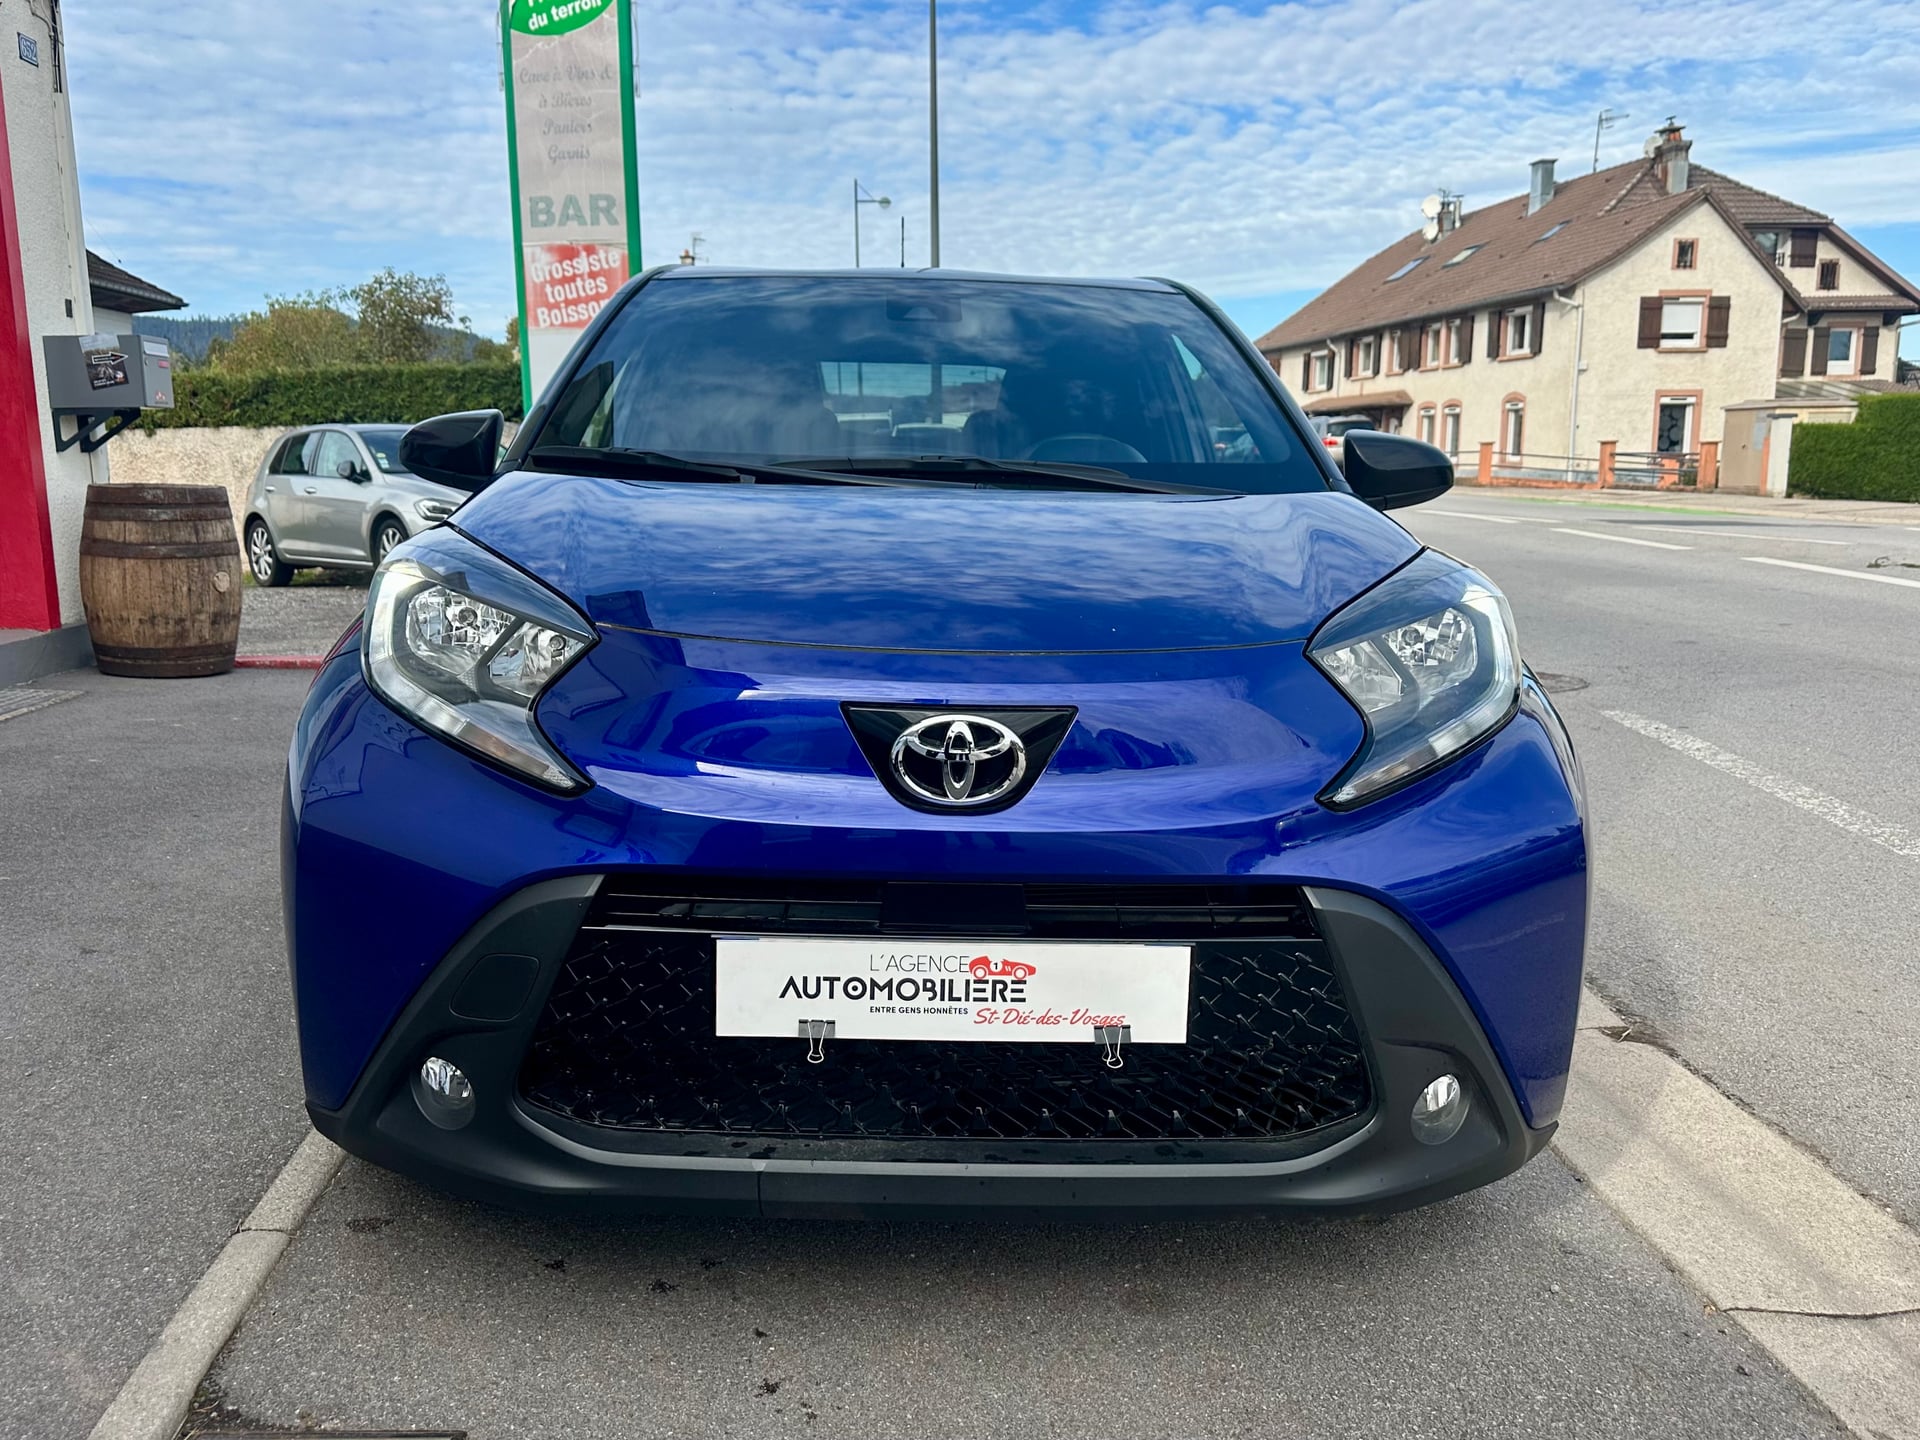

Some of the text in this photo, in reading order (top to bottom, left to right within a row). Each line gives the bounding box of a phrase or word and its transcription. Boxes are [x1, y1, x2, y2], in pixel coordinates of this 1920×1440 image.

[528, 12, 549, 31] du
[548, 144, 591, 165] Garnis
[529, 193, 620, 228] BAR
[544, 276, 609, 304] toutes
[870, 953, 969, 973] L'AGENCE
[870, 1005, 969, 1016] ENTRE GENS HONNÊTES
